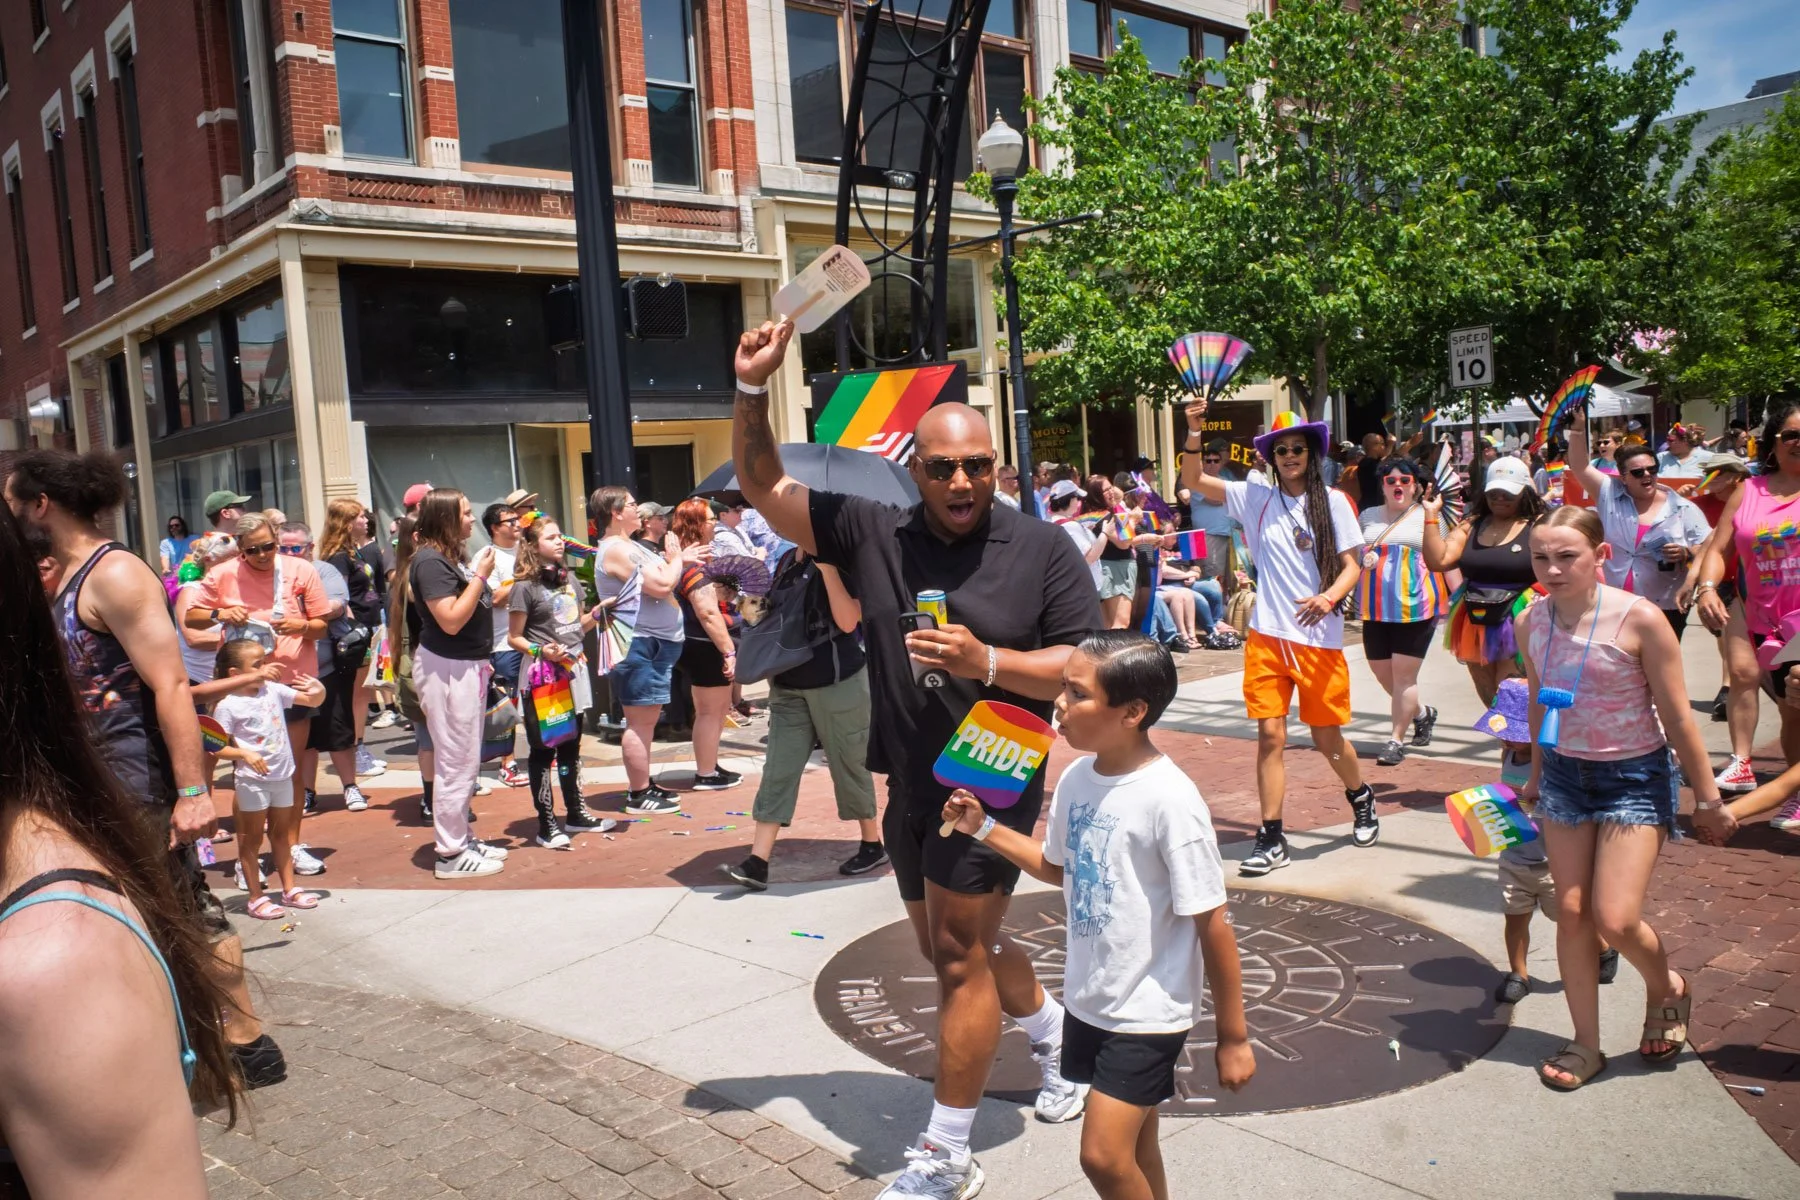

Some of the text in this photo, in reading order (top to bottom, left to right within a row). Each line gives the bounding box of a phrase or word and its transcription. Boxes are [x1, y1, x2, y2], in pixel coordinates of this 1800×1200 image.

[1452, 333, 1488, 345] SPEED
[1457, 346, 1484, 357] LIMIT
[1458, 359, 1486, 381] 10
[1201, 421, 1232, 431] ROPER
[1032, 427, 1066, 438] MOUS
[1756, 560, 1777, 571] WE
[952, 724, 1040, 781] PRIDE
[1464, 788, 1517, 848] PRIDE
[1227, 892, 1435, 946] ANSVILLE
